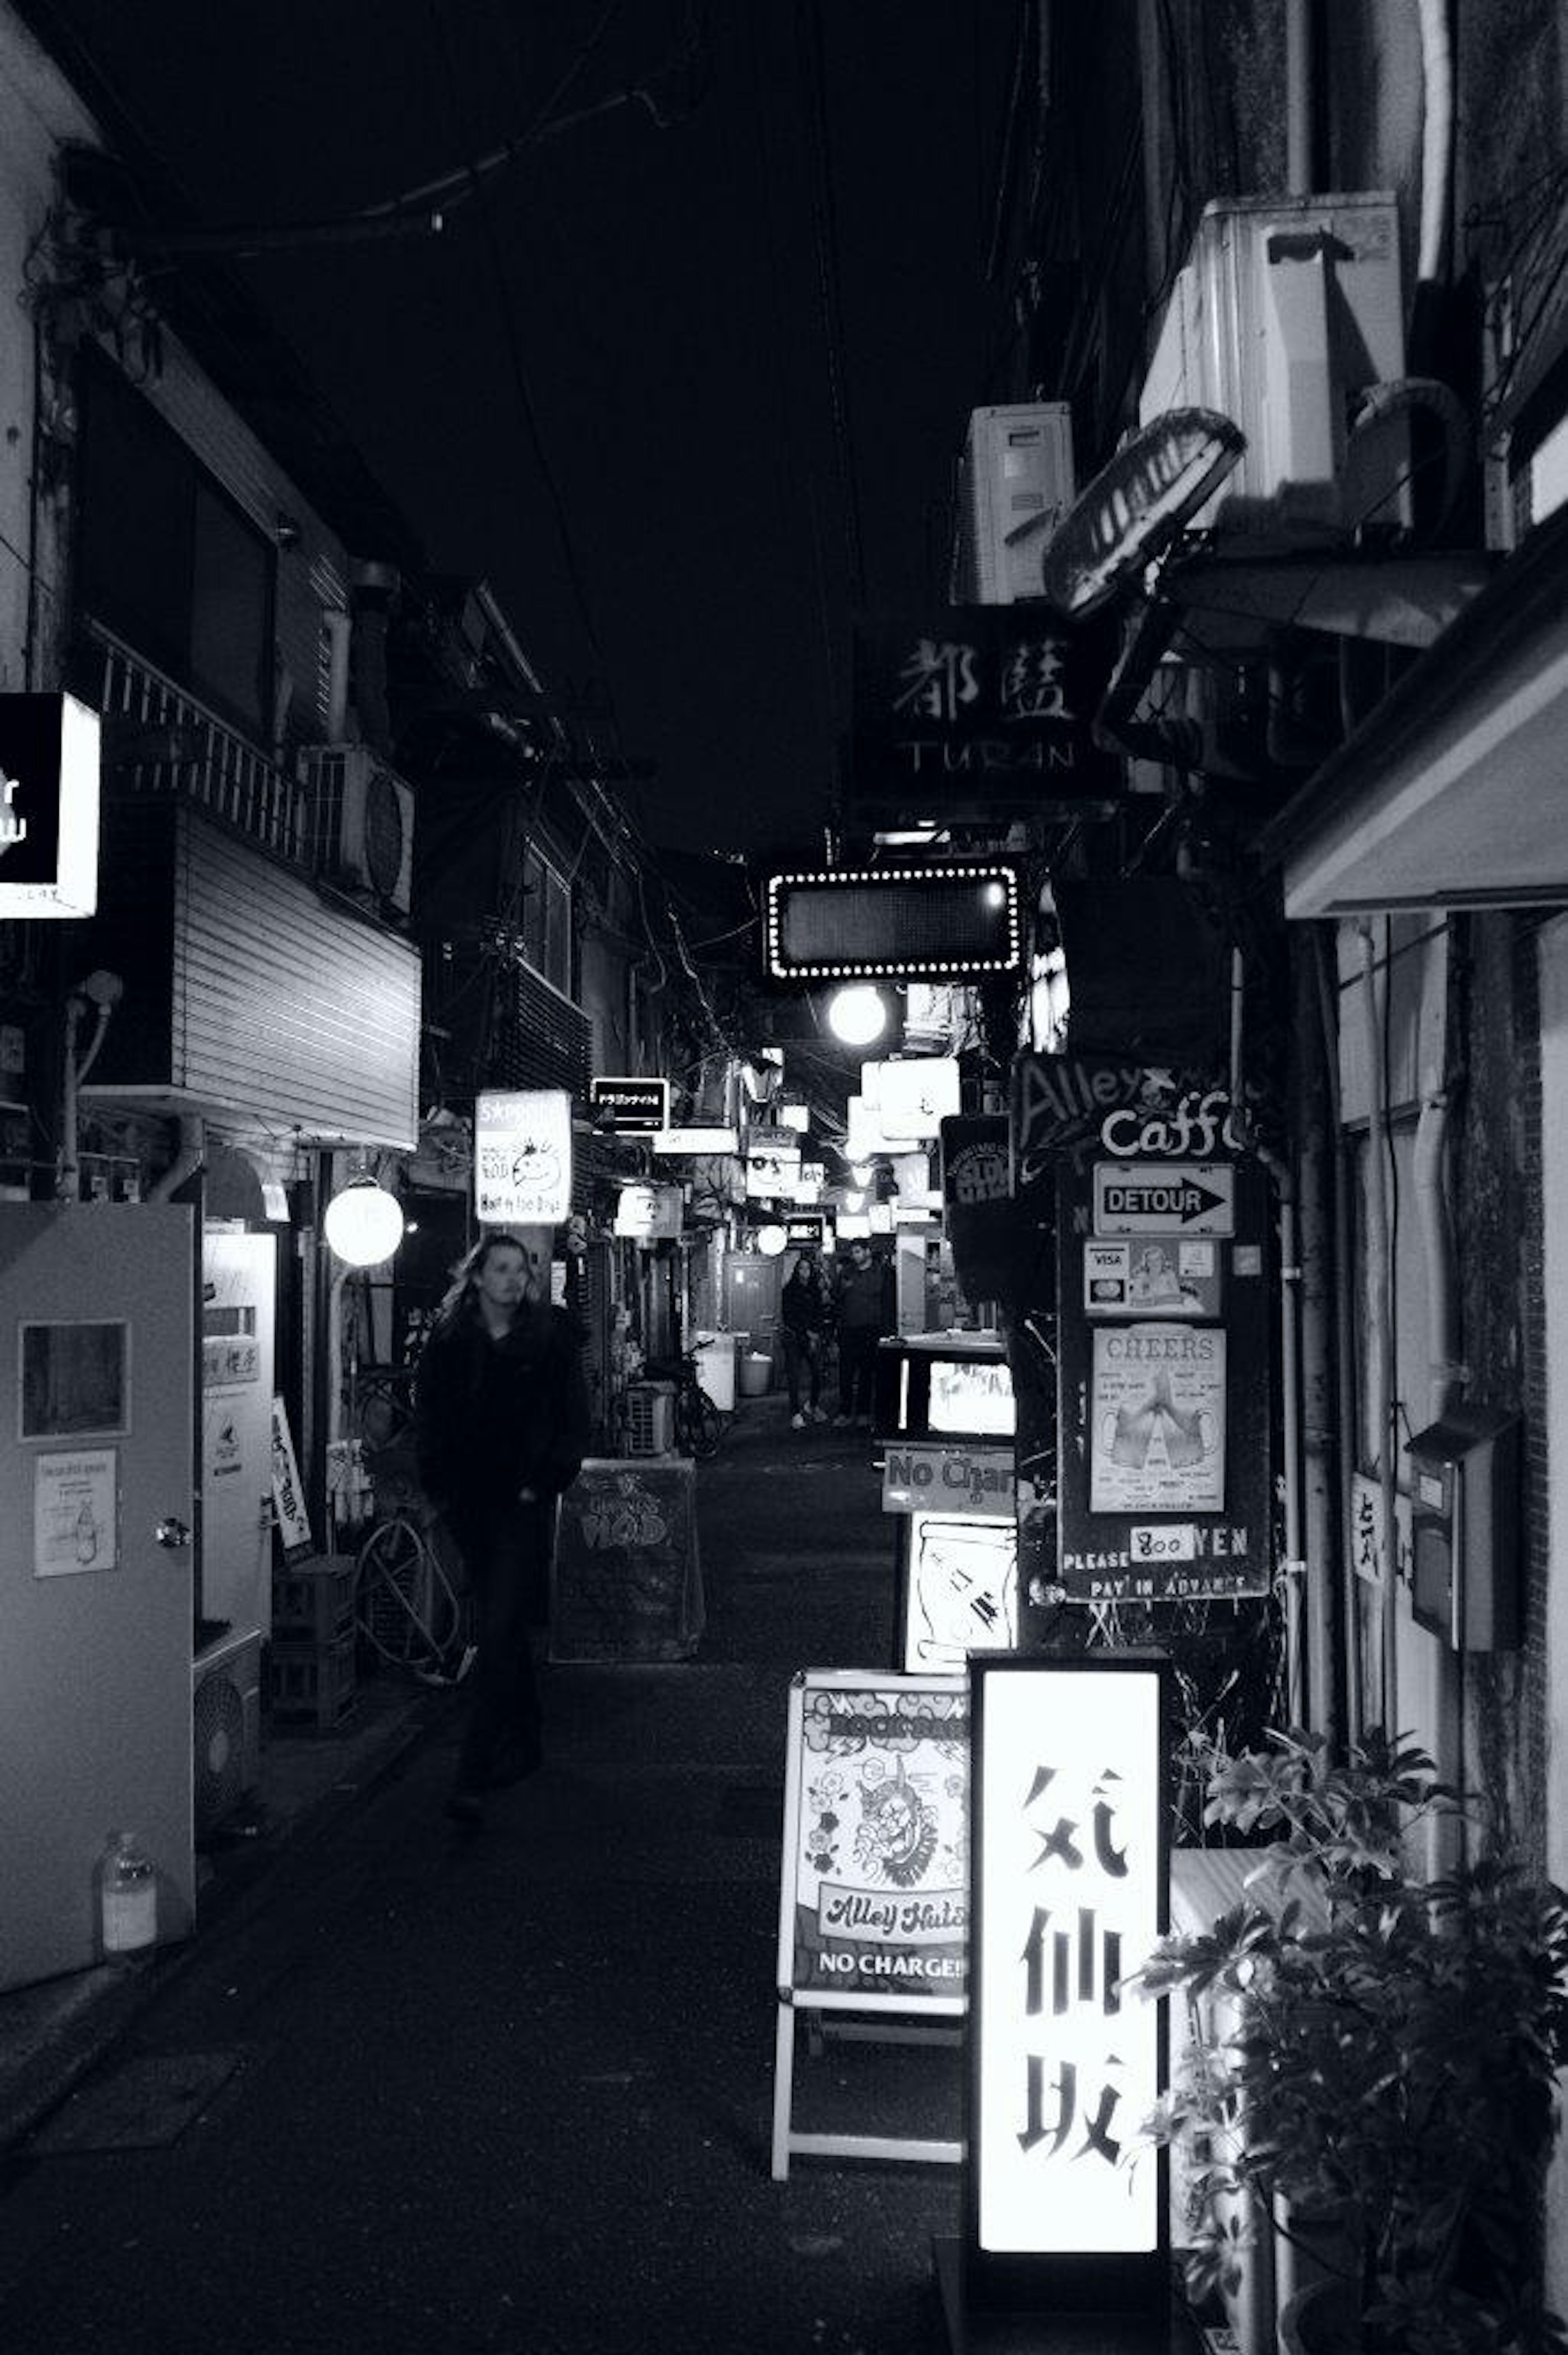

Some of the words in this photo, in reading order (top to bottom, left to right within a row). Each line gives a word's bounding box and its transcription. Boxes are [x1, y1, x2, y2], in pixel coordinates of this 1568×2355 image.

[1021, 1061, 1141, 1149] Alley
[1109, 1189, 1202, 1211] DETOUR
[1095, 1254, 1123, 1265] VISA
[1107, 1337, 1214, 1360] CHEERS
[889, 1456, 935, 1487] No
[1138, 1531, 1180, 1556] 800
[1194, 1528, 1247, 1557] YEN
[1063, 1553, 1130, 1570] PLEASE
[1091, 1579, 1125, 1597] PAY
[1136, 1579, 1153, 1596] IN
[1165, 1576, 1245, 1595] ADVANE
[826, 1895, 898, 1936] Alley
[819, 1952, 856, 1972] NO
[858, 1954, 961, 1978] CHARGE!
